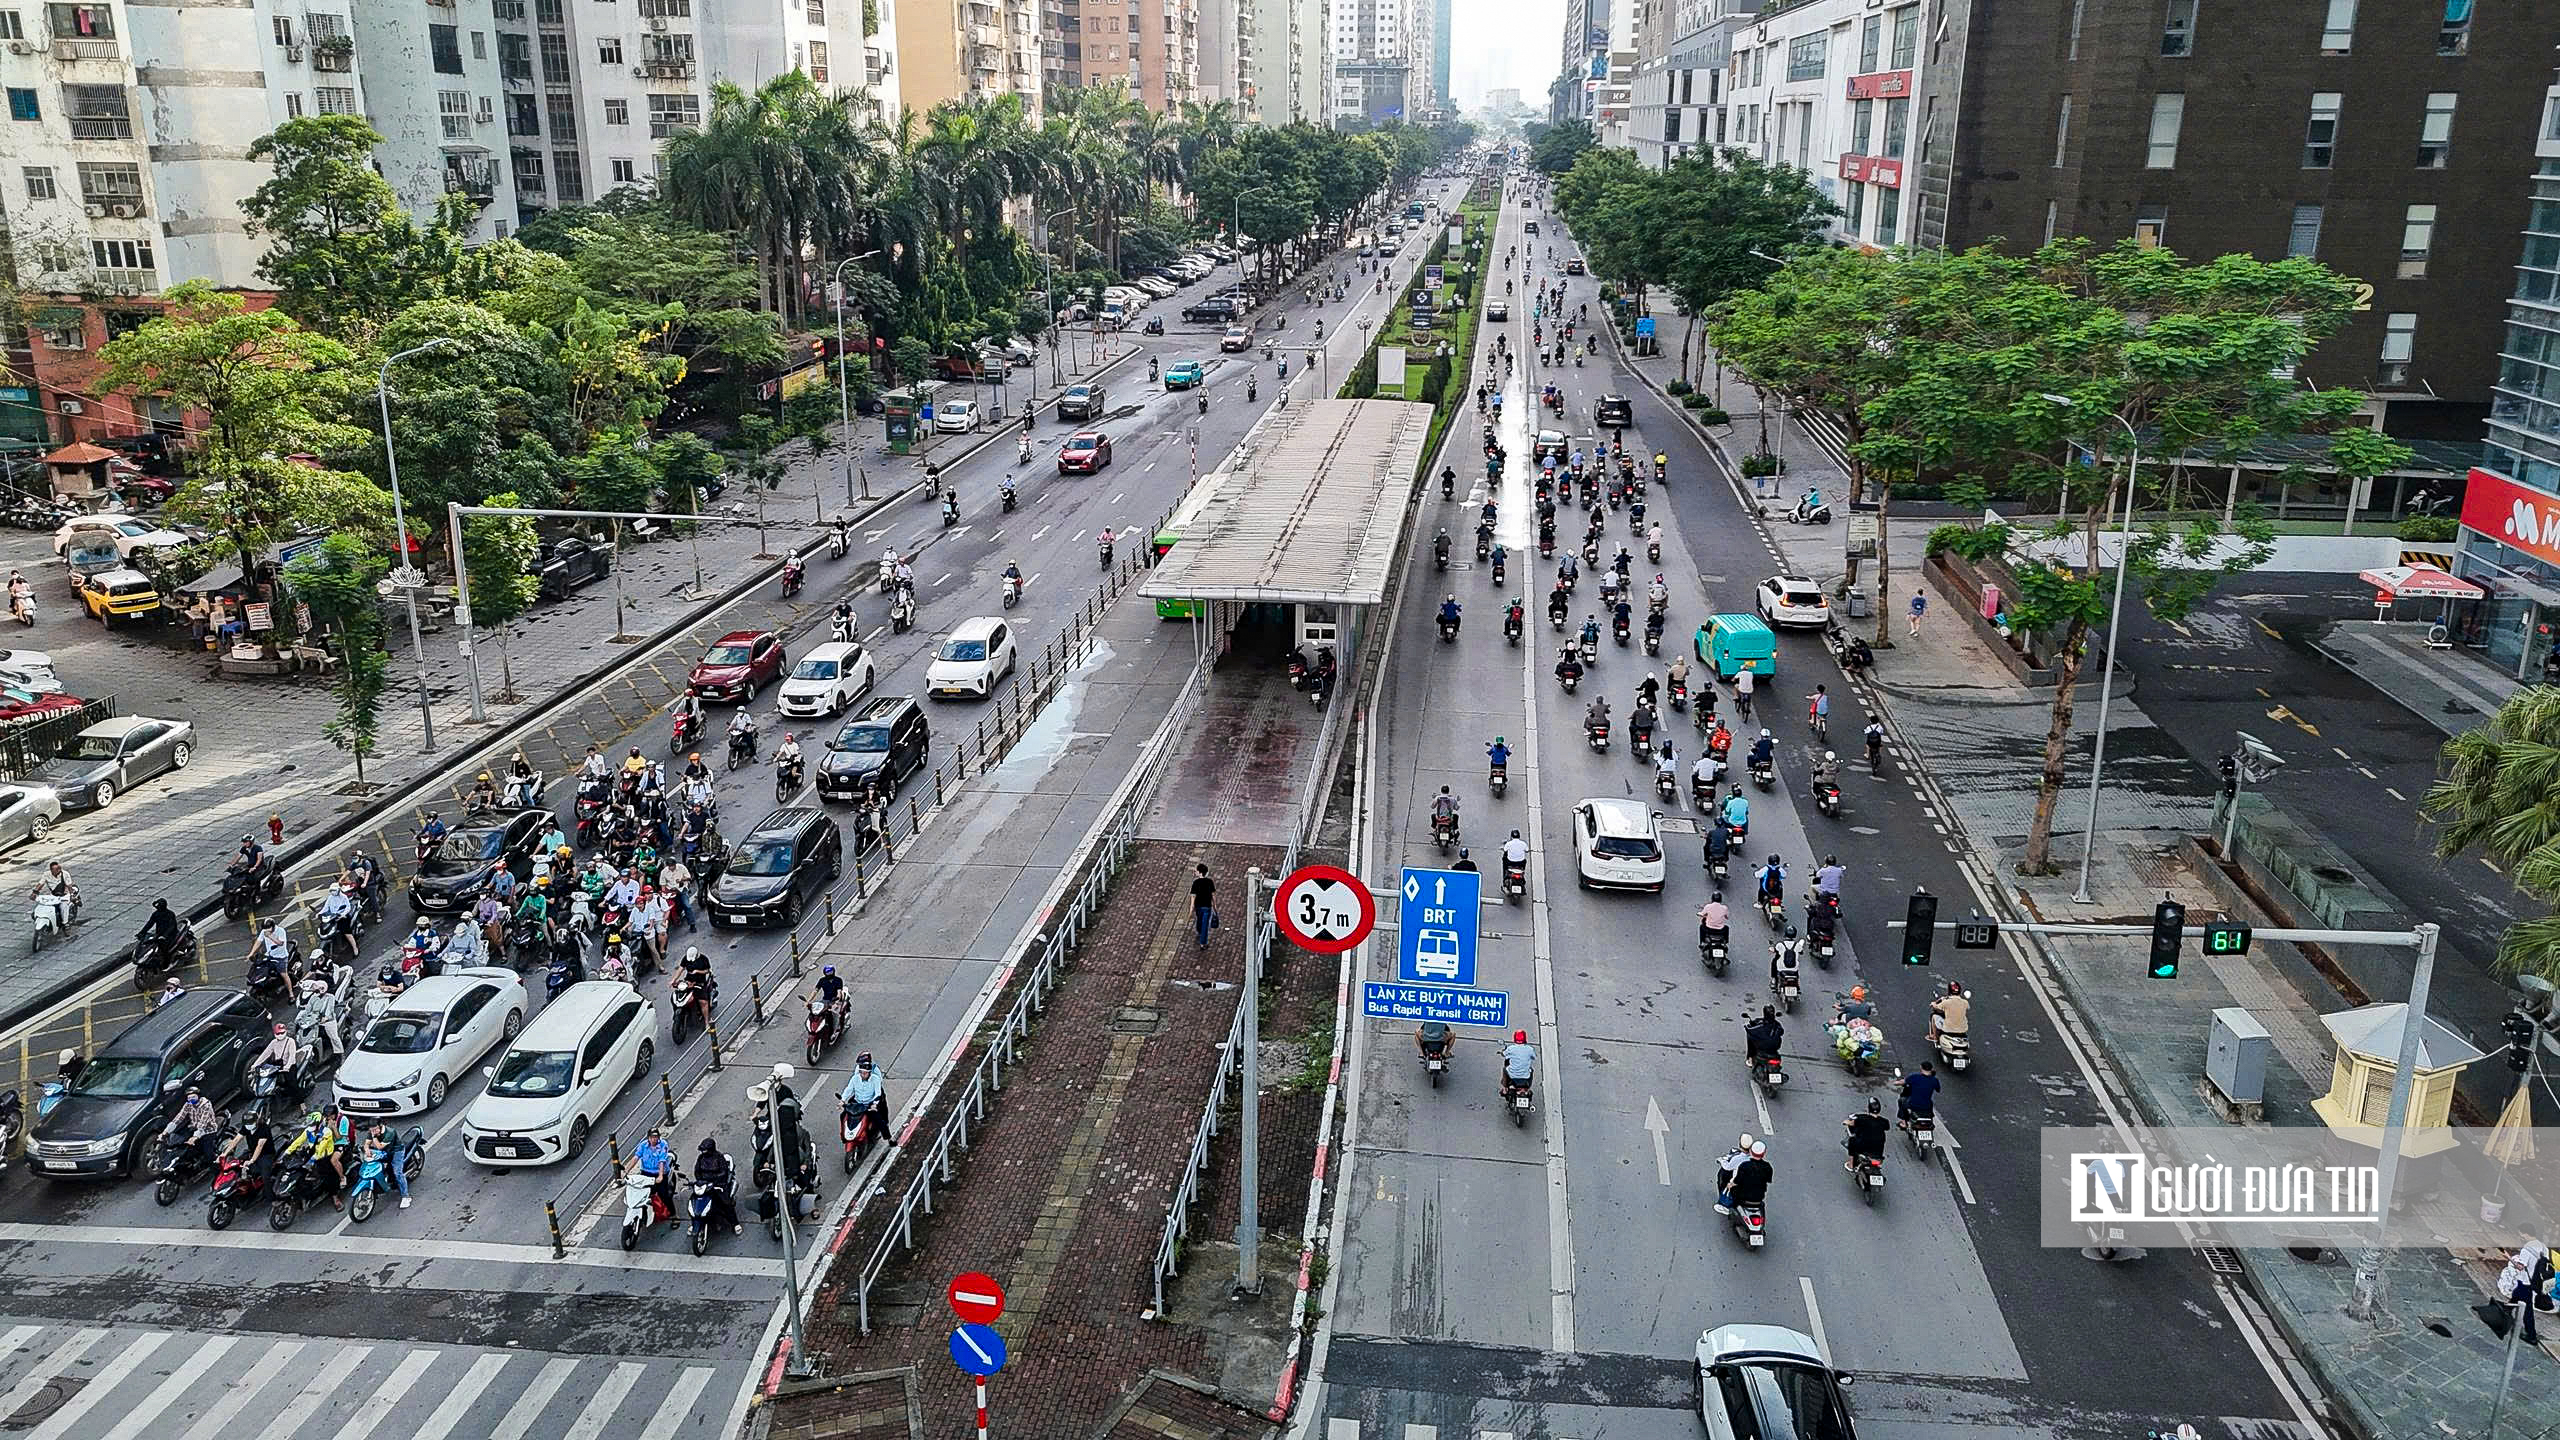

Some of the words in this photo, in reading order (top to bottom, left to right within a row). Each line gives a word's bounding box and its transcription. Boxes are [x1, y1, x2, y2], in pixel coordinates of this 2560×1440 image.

[1336, 913, 1350, 927] m
[1424, 908, 1456, 925] BRT
[2214, 932, 2242, 950] 61
[1368, 986, 1396, 1001] LÀN
[1399, 989, 1417, 1002] XE
[1419, 990, 1454, 1005] BUÝT
[1457, 994, 1502, 1009] NHANH
[1368, 1001, 1389, 1013] Bus
[1392, 1003, 1422, 1017] Rapid
[1426, 1006, 1461, 1019] Transit
[1468, 1008, 1501, 1022] (BRT)
